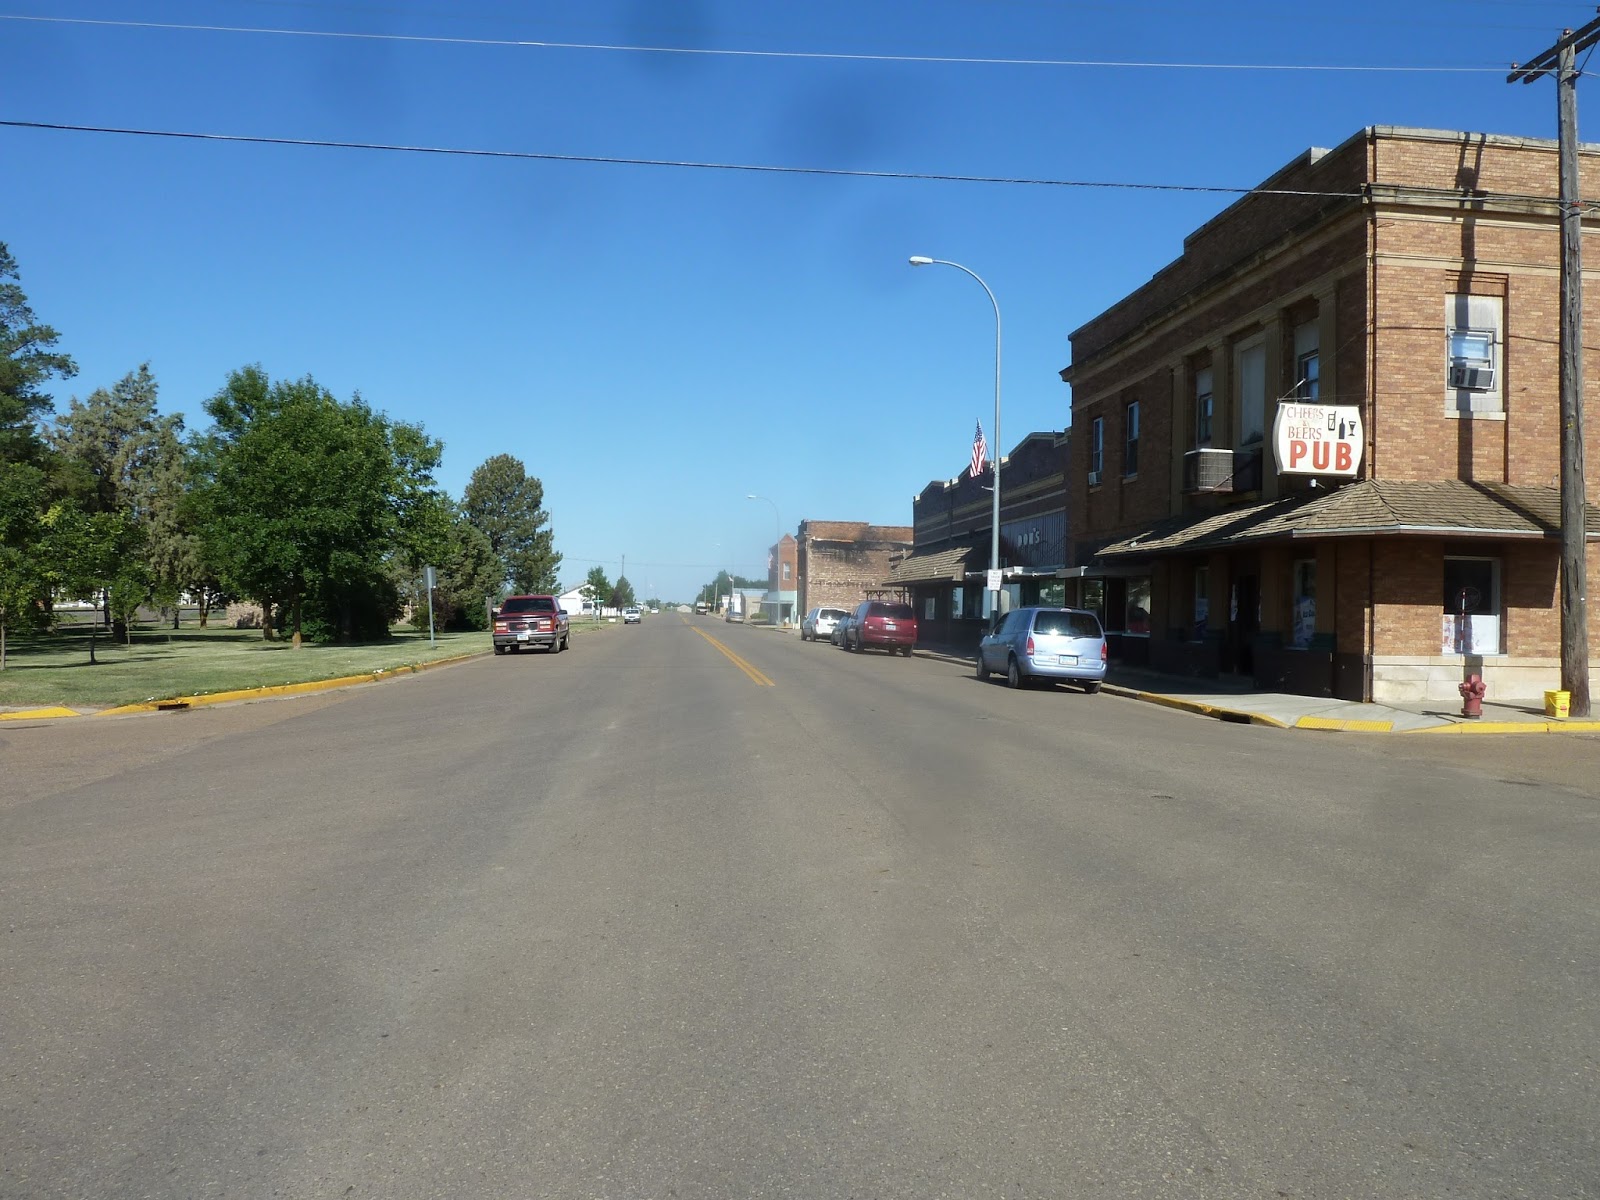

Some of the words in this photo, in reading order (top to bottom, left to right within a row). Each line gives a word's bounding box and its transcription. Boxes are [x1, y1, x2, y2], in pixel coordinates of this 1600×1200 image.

[1287, 406, 1324, 420] CHEERS
[1288, 425, 1322, 440] BEERS
[1289, 440, 1353, 471] PUB
